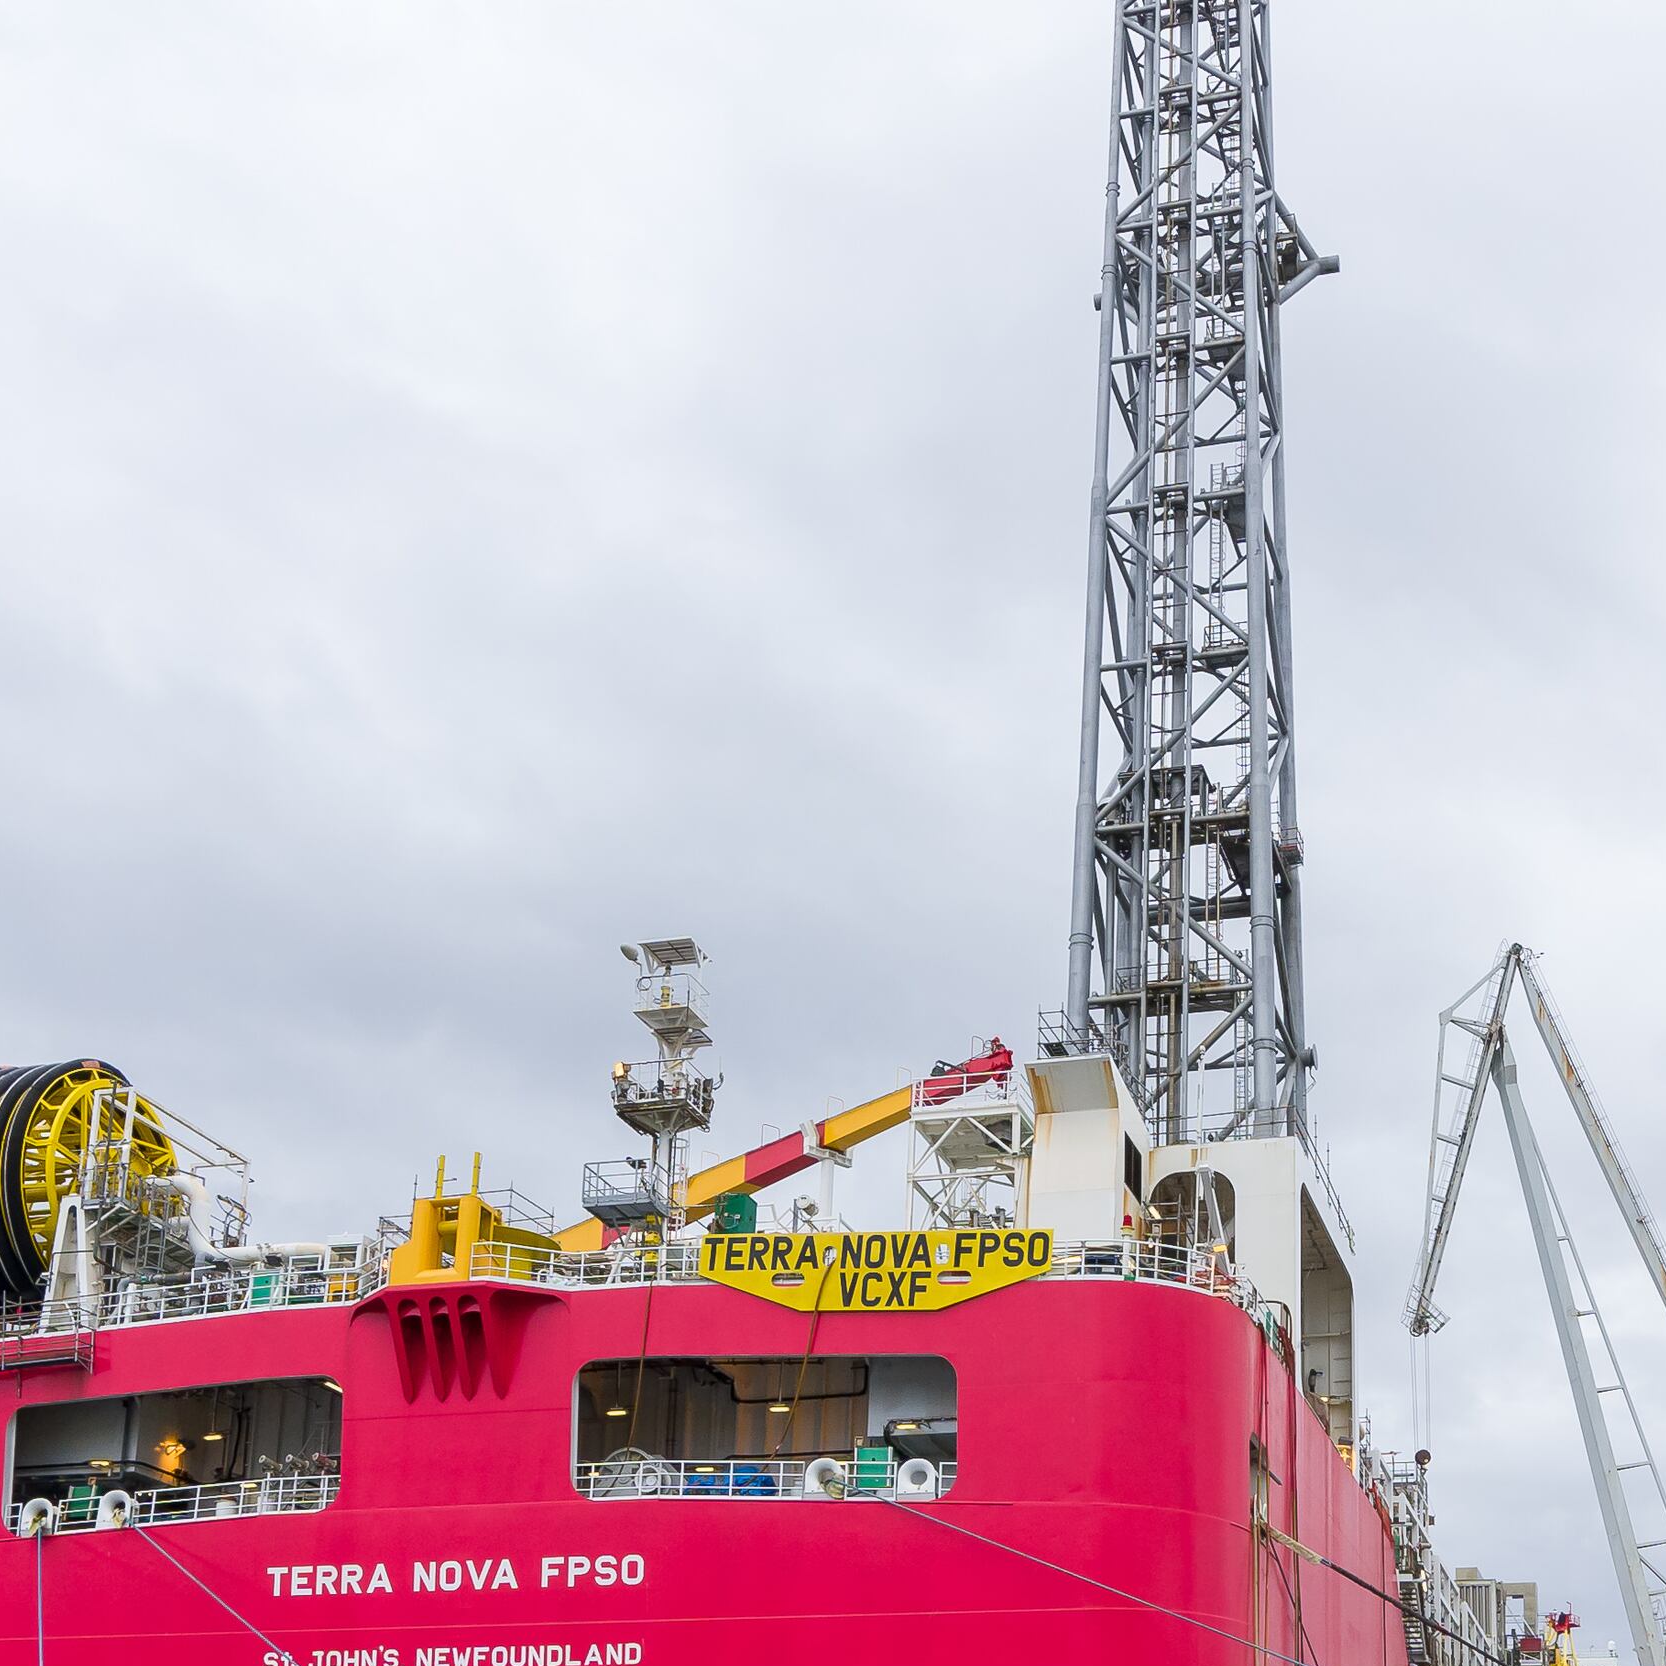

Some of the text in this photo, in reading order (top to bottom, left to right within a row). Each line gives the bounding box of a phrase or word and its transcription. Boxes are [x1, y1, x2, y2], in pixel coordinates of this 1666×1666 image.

[704, 1231, 1050, 1271] TERRA NOVA FPSO
[839, 1270, 932, 1307] VCXF
[266, 1554, 646, 1597] TERRA NOVA FPSO
